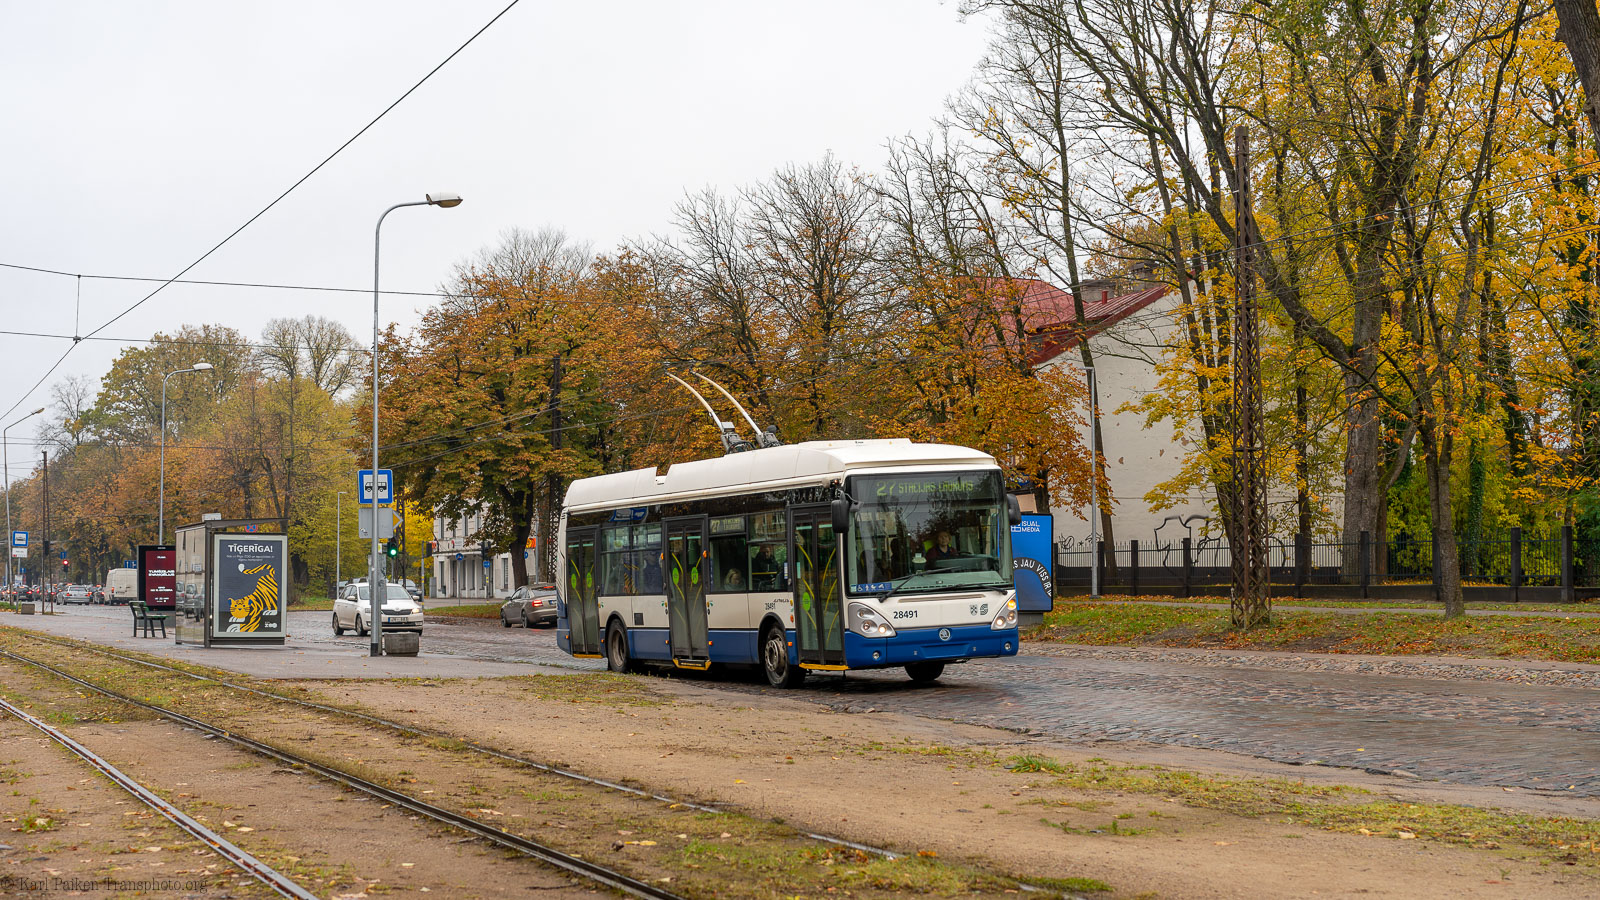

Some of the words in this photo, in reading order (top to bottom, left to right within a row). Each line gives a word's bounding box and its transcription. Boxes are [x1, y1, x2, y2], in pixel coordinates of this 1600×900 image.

[877, 480, 896, 496] 27
[228, 543, 273, 554] TĪĢERĪGA!
[1020, 559, 1035, 569] JAU
[1036, 564, 1049, 581] VISS
[893, 610, 919, 619] 28491
